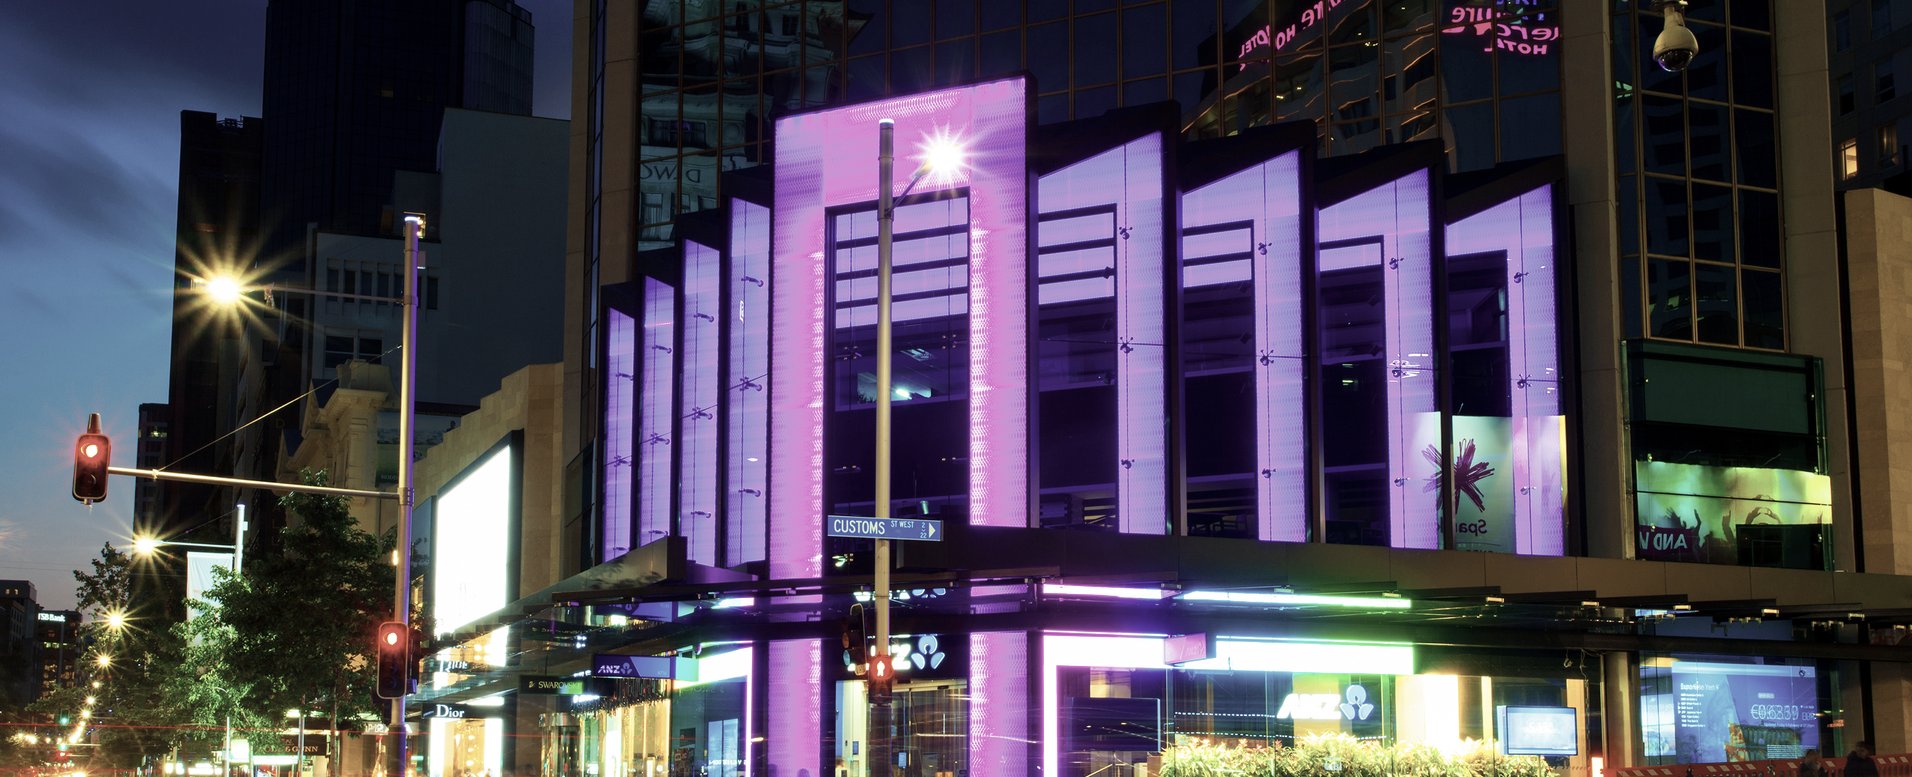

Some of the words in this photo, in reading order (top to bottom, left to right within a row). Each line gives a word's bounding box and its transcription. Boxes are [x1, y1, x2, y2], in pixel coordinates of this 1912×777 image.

[833, 519, 886, 535] CUSTOMS
[899, 521, 914, 529] WEST
[49, 613, 66, 622] Bank
[597, 664, 621, 674] ANZ
[436, 704, 465, 718] Dior
[292, 745, 319, 753] GNN
